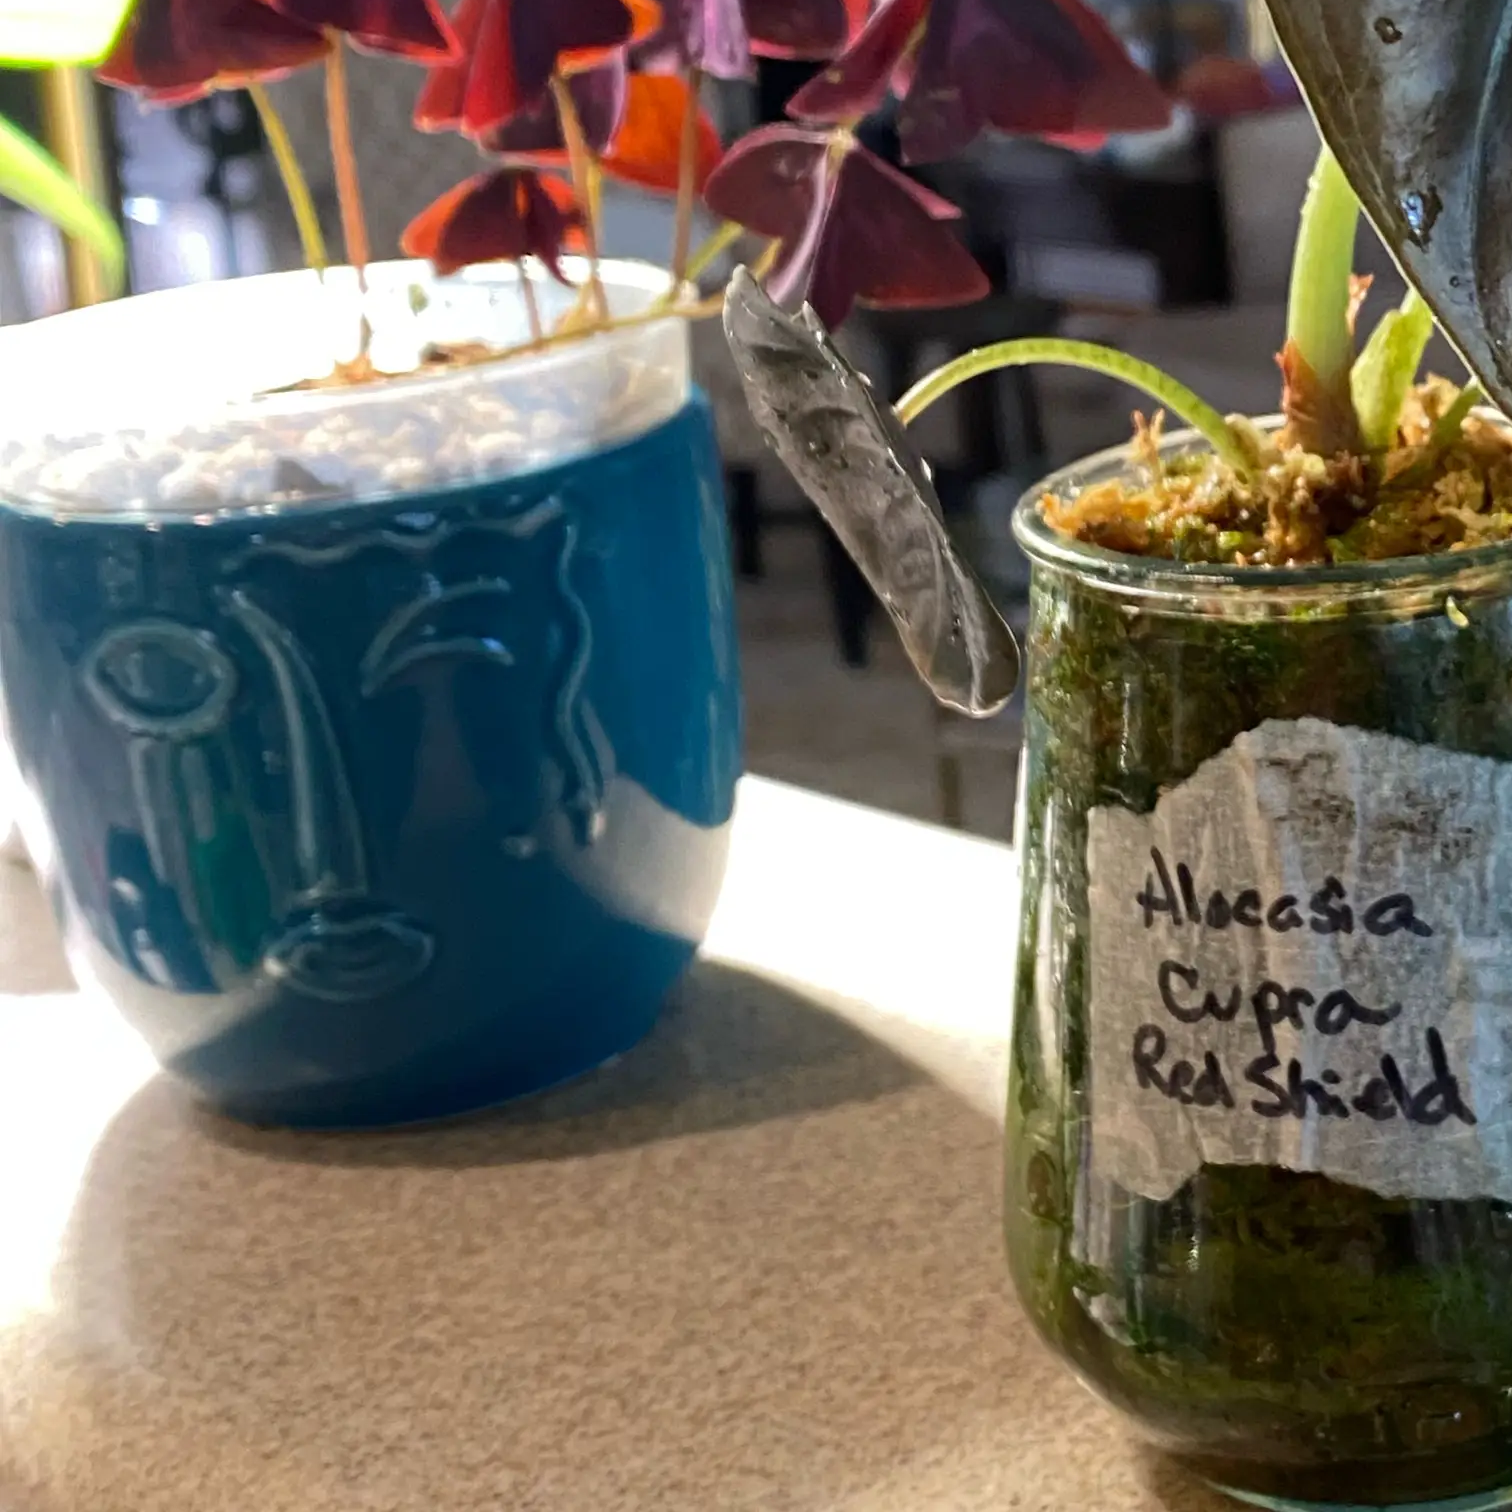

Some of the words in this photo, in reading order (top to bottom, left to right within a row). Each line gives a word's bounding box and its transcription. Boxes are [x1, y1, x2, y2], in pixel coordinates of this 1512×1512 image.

[1136, 845, 1434, 938] Alocasia
[1158, 960, 1402, 1054] Cupra
[1132, 1023, 1236, 1109] Red
[1244, 1026, 1478, 1127] Shield
